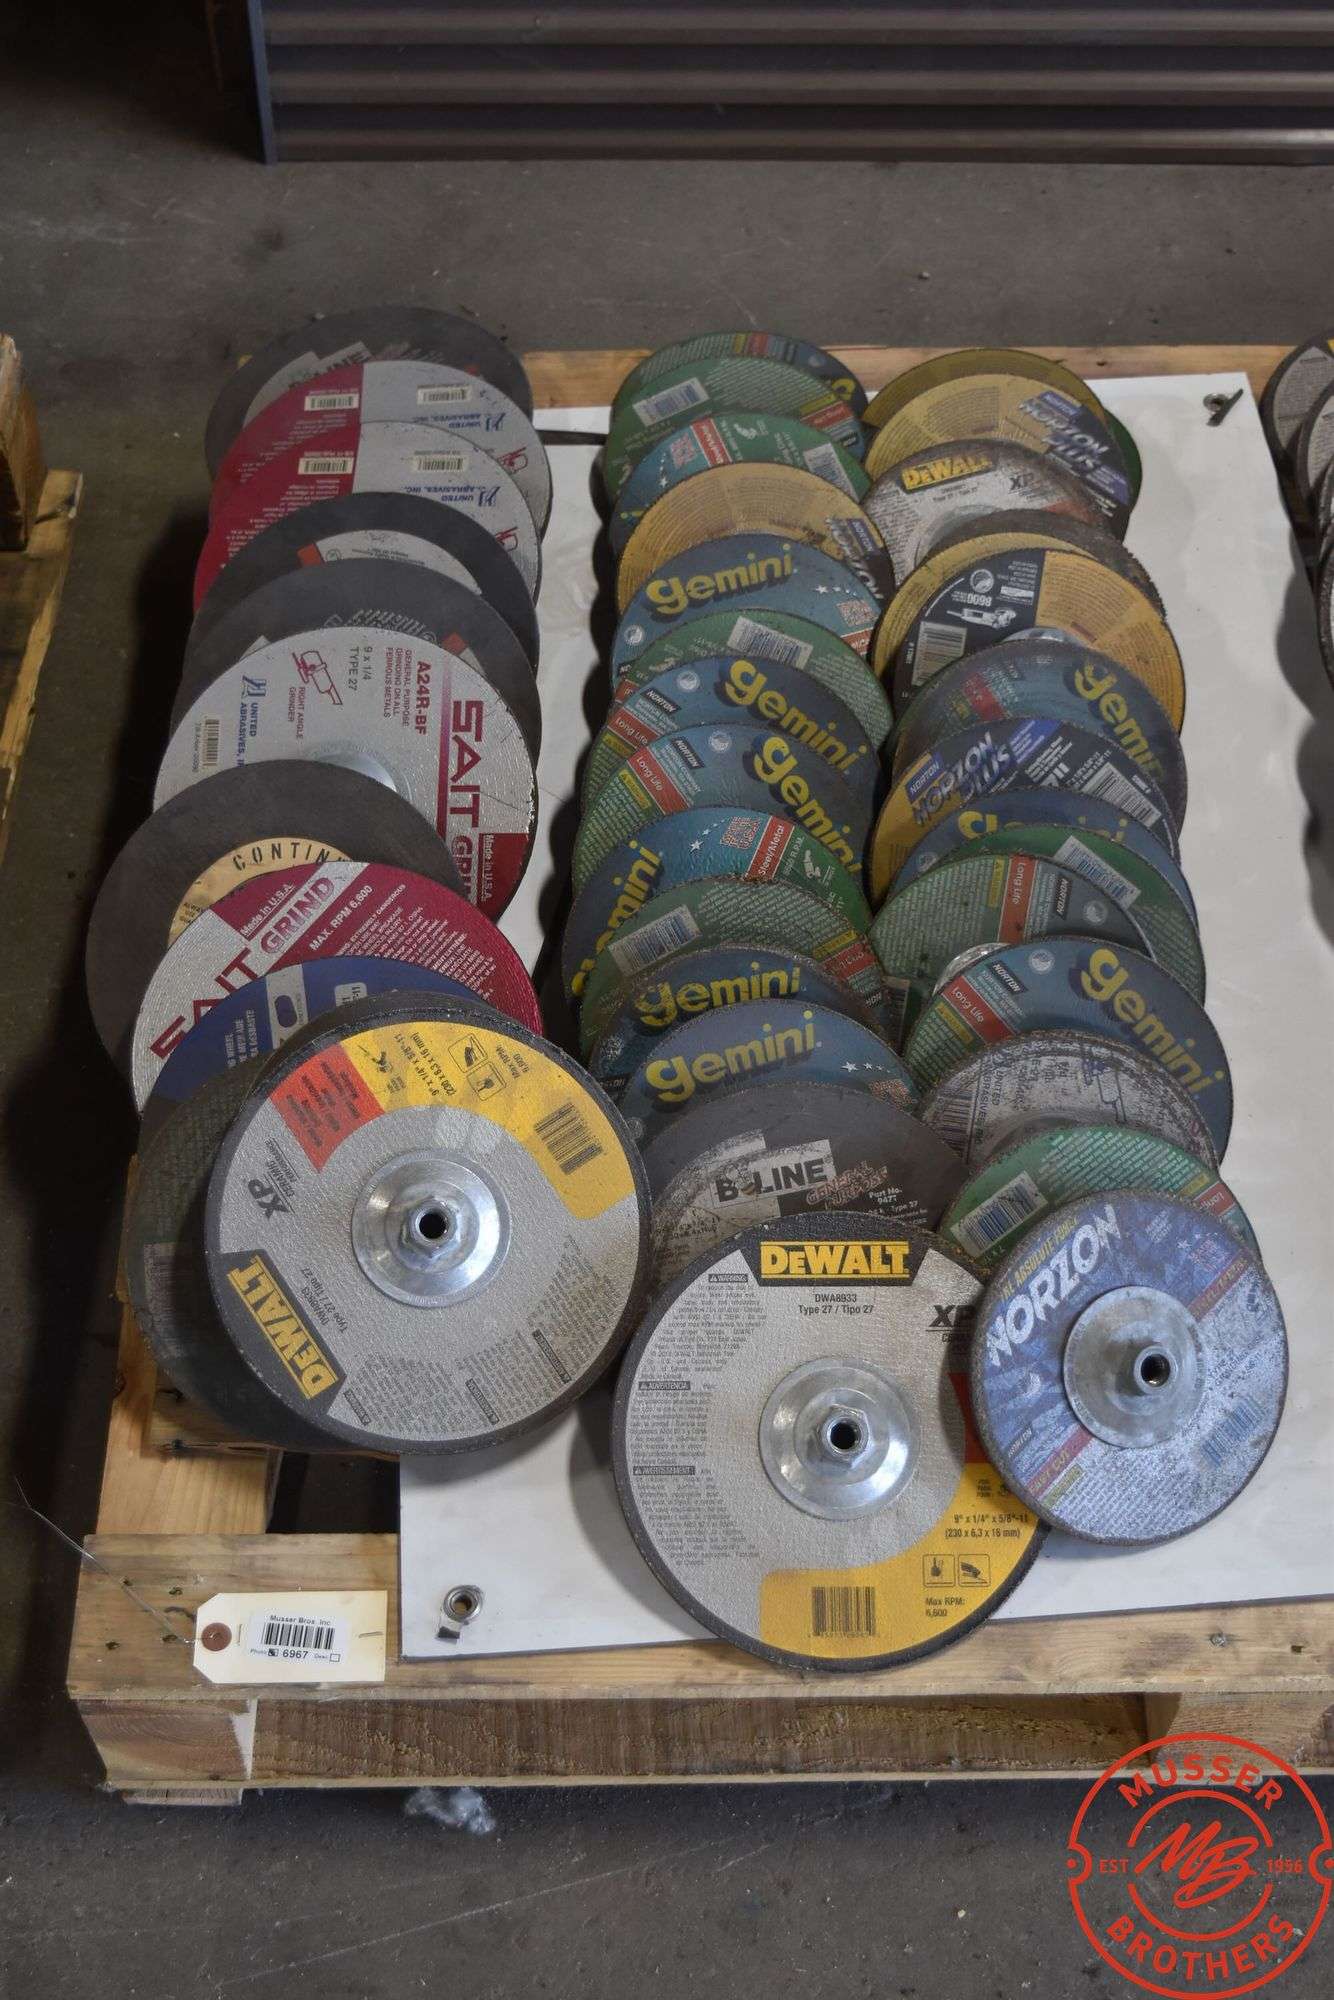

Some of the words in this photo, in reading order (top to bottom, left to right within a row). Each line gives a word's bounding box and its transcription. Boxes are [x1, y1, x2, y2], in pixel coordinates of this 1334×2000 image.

[646, 544, 793, 614] gemini
[967, 591, 992, 606] 8600
[348, 647, 359, 675] TYPE
[362, 666, 372, 680] 1/4
[297, 687, 305, 710] RIGHT
[348, 678, 358, 691] 27
[414, 661, 431, 735] A24R-BF
[287, 687, 295, 722] GRINDER
[646, 689, 676, 712] NORTON
[249, 703, 258, 737] UNITED
[296, 712, 305, 740] ANGLE
[725, 660, 868, 772] gemini
[614, 717, 637, 737] Long
[633, 730, 650, 746] Life
[450, 700, 483, 828] SAIT
[636, 756, 652, 781] Long
[676, 740, 700, 768] NORTON
[910, 762, 941, 794] NORTON
[233, 841, 348, 870] CONTIN
[758, 823, 785, 876] Steel/Metal
[1011, 862, 1027, 886] Long
[1011, 888, 1022, 905] Life
[1053, 878, 1071, 916] NORTON
[240, 911, 265, 938] Made
[257, 870, 339, 962] GRIND
[309, 925, 334, 952] MAX.
[329, 904, 354, 930] RPM
[348, 882, 374, 911] 6,600
[992, 963, 1021, 992] NORTON
[634, 962, 801, 1028] gemini
[950, 985, 974, 1011] Long
[968, 1006, 987, 1025] Life
[1082, 948, 1225, 1092] gemini
[644, 1011, 816, 1103] gemini
[991, 1070, 1003, 1105] UNITED
[265, 1159, 297, 1199] CERAMIC
[247, 1179, 290, 1219] XP
[301, 1265, 315, 1279] 27
[761, 1245, 910, 1275] DEWALT
[308, 1275, 327, 1297] Tipo
[815, 1293, 857, 1302] DWA8933
[986, 1203, 1122, 1367] NORZON
[323, 1300, 336, 1314] 27
[799, 1305, 820, 1316] Type
[821, 1305, 833, 1313] 27
[841, 1305, 861, 1315] Tipo
[863, 1305, 874, 1314] 27
[231, 1255, 336, 1398] DEWALT
[329, 1310, 350, 1334] Type
[945, 1529, 962, 1540] (230
[1003, 1529, 1021, 1539] mm)
[926, 1597, 942, 1606] Max
[944, 1597, 966, 1606] RPM:
[270, 1614, 297, 1624] Musser
[282, 1649, 309, 1660] 6967
